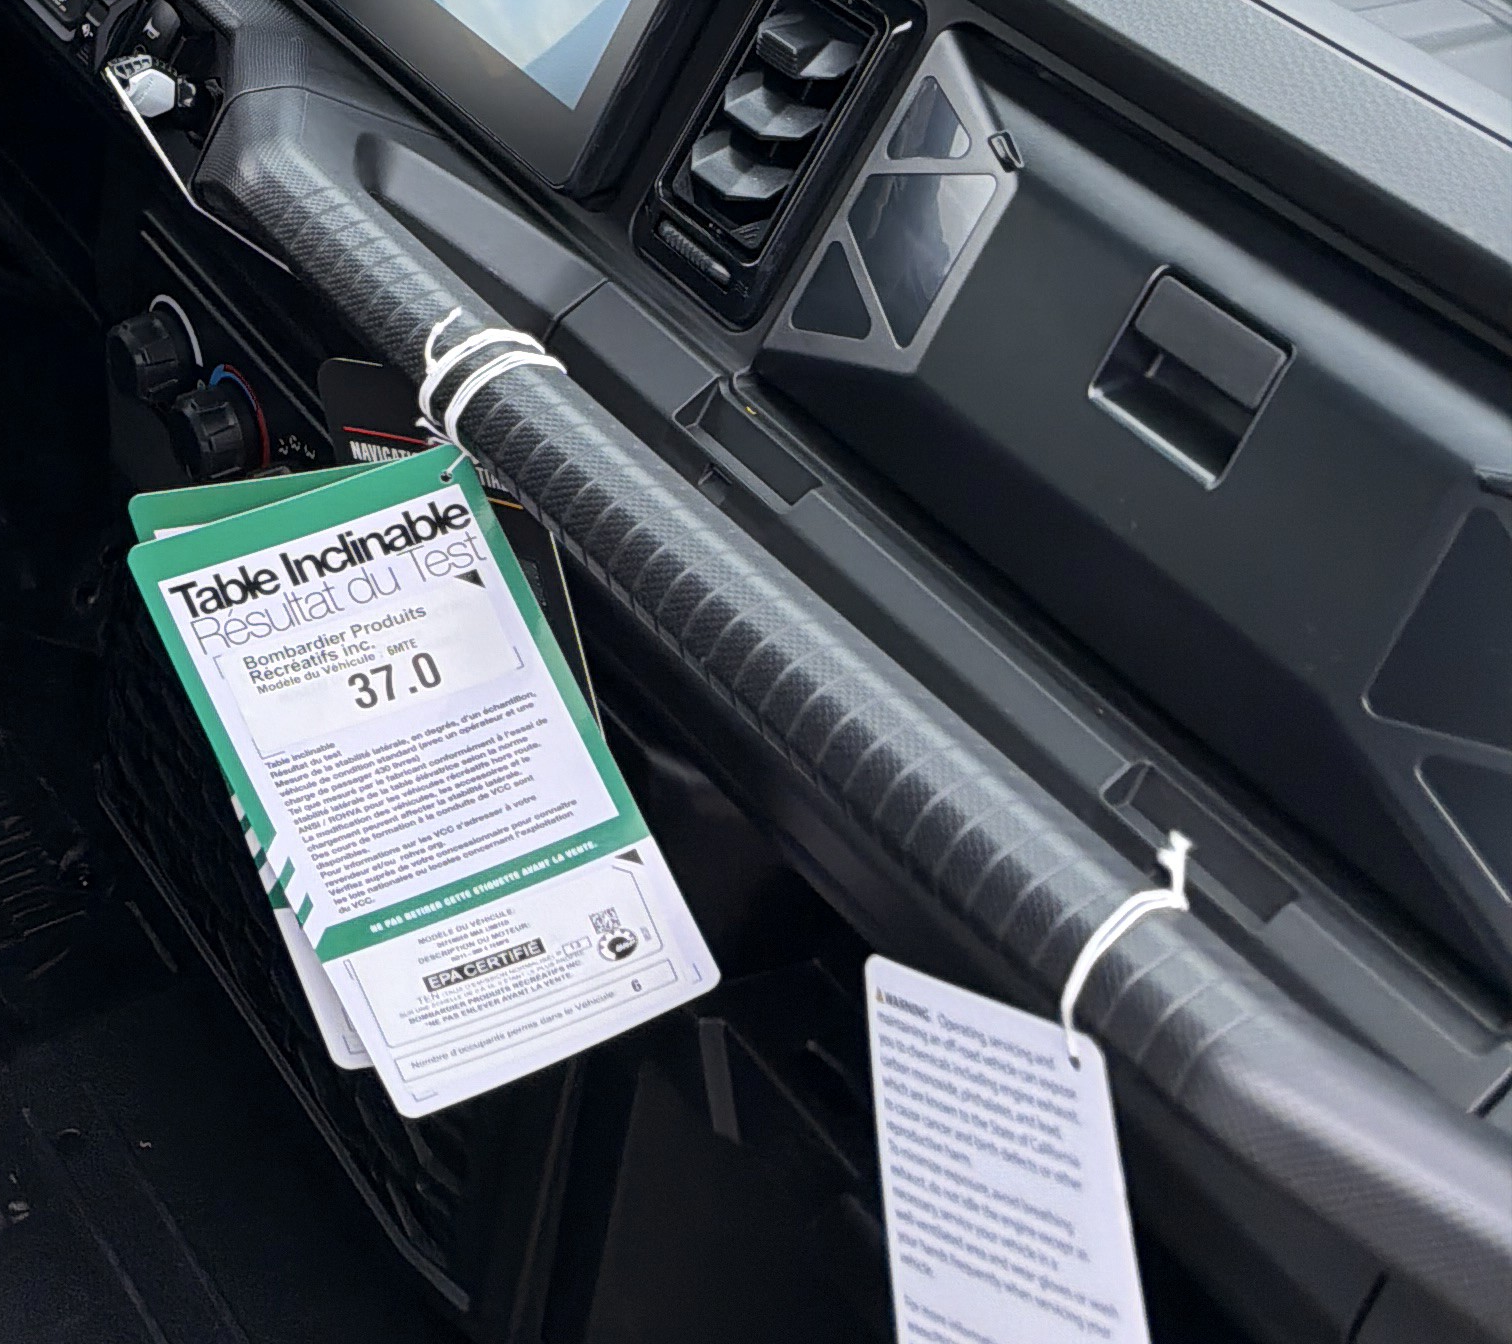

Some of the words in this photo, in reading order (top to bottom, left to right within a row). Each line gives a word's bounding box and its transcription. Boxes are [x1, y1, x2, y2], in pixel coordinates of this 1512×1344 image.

[168, 565, 281, 619] Table
[279, 501, 471, 587] Inclinable
[189, 580, 346, 656] Résultat
[347, 566, 402, 605] du
[396, 530, 488, 583] Test
[242, 631, 346, 677] Bombardier
[349, 606, 427, 639] Produits
[248, 643, 339, 690] Récréatifs
[340, 640, 376, 657] inc.
[256, 676, 302, 695] Modèle
[303, 670, 321, 681] du
[320, 649, 376, 675] Véhicule
[347, 652, 442, 709] 37.0
[264, 757, 291, 770] Table
[290, 742, 336, 762] inclinable
[269, 761, 309, 780] Résultat
[309, 757, 323, 767] du
[322, 750, 343, 762] test
[278, 781, 318, 798] véhicule
[318, 776, 331, 785] de
[332, 760, 376, 780] condition
[376, 744, 418, 765] standard
[444, 731, 458, 740] un
[274, 773, 310, 789] Mesure
[310, 768, 323, 777] de
[284, 792, 316, 807] charge
[317, 787, 330, 796] de
[374, 764, 392, 775] 430
[366, 791, 379, 800] de
[389, 779, 414, 792] table
[287, 806, 303, 816] Tel
[303, 800, 322, 812] que
[298, 821, 322, 835] ANSI
[363, 799, 385, 813] pour
[551, 853, 566, 864] LA
[428, 971, 464, 989] EPA
[463, 941, 542, 977] CERTIFIÉ
[630, 979, 642, 993] 6
